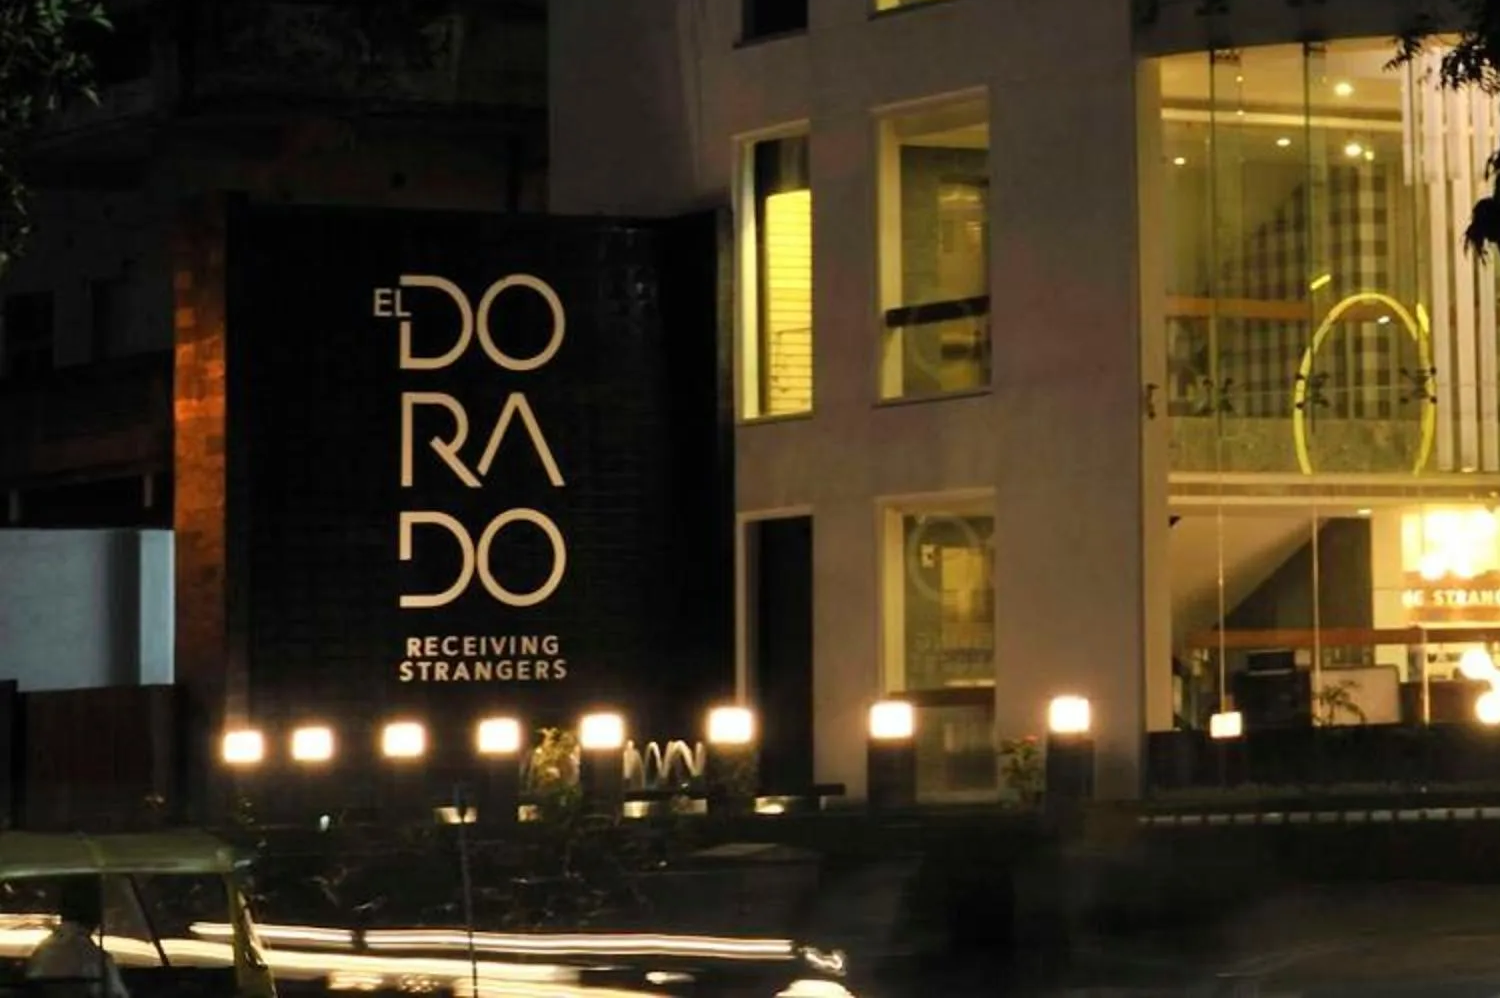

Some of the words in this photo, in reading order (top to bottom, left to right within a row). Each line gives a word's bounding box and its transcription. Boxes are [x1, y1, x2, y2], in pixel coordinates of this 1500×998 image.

[373, 288, 412, 317] EL
[399, 507, 567, 608] DO
[406, 635, 560, 658] RECEIVING
[400, 659, 567, 682] STRANGERS
